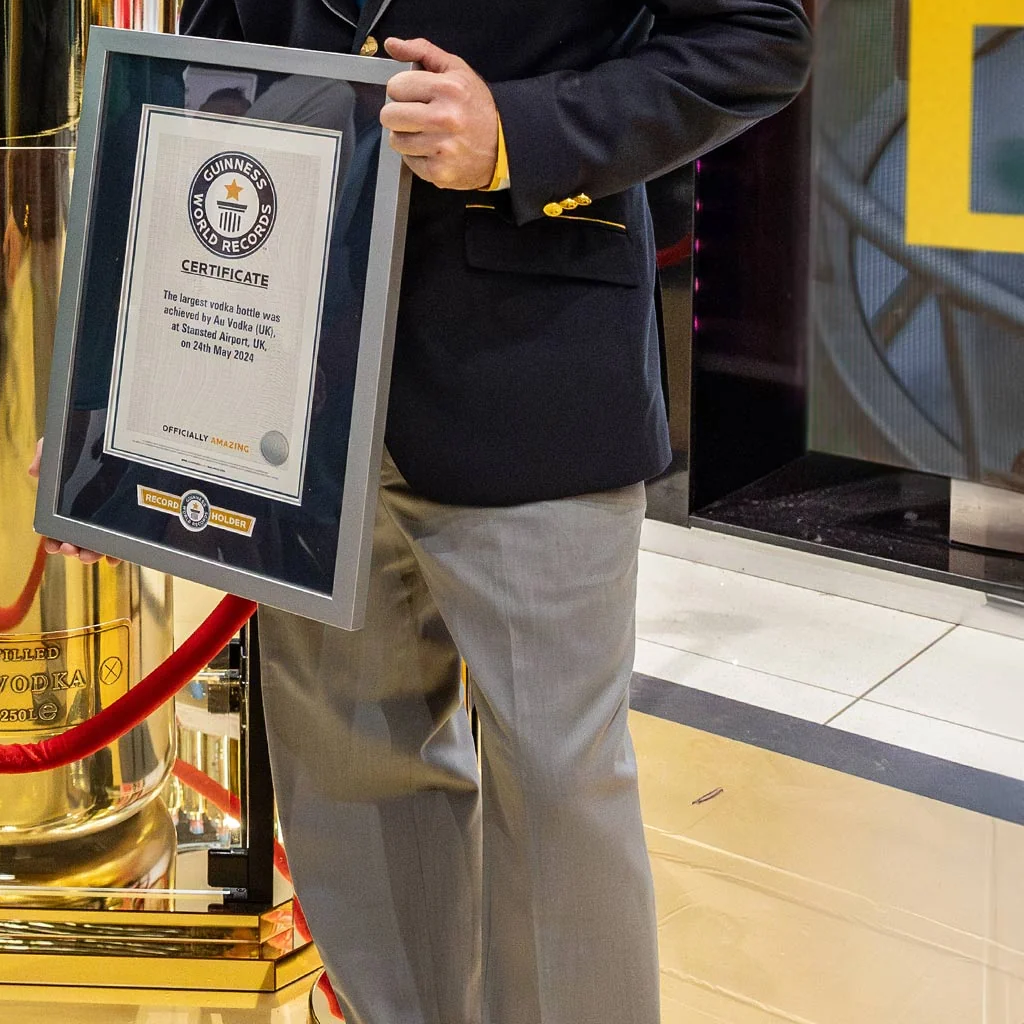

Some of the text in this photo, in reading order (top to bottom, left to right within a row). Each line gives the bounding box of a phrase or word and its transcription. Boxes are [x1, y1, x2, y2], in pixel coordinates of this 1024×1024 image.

[203, 158, 267, 190] GUINNESS
[193, 193, 272, 253] WORLD RECORDS
[181, 259, 269, 287] CERTIFICATE
[163, 289, 281, 323] The largest vodka bottle was
[163, 306, 199, 321] achieved
[201, 312, 212, 326] by
[213, 315, 225, 326] Au
[227, 317, 253, 332] Vodka
[171, 322, 180, 332] at
[181, 323, 218, 340] Stansted
[180, 340, 254, 363] on 24th May 2024
[162, 424, 249, 453] OFFICIALLY AMAZING
[145, 493, 247, 528] RECORD HOLDER
